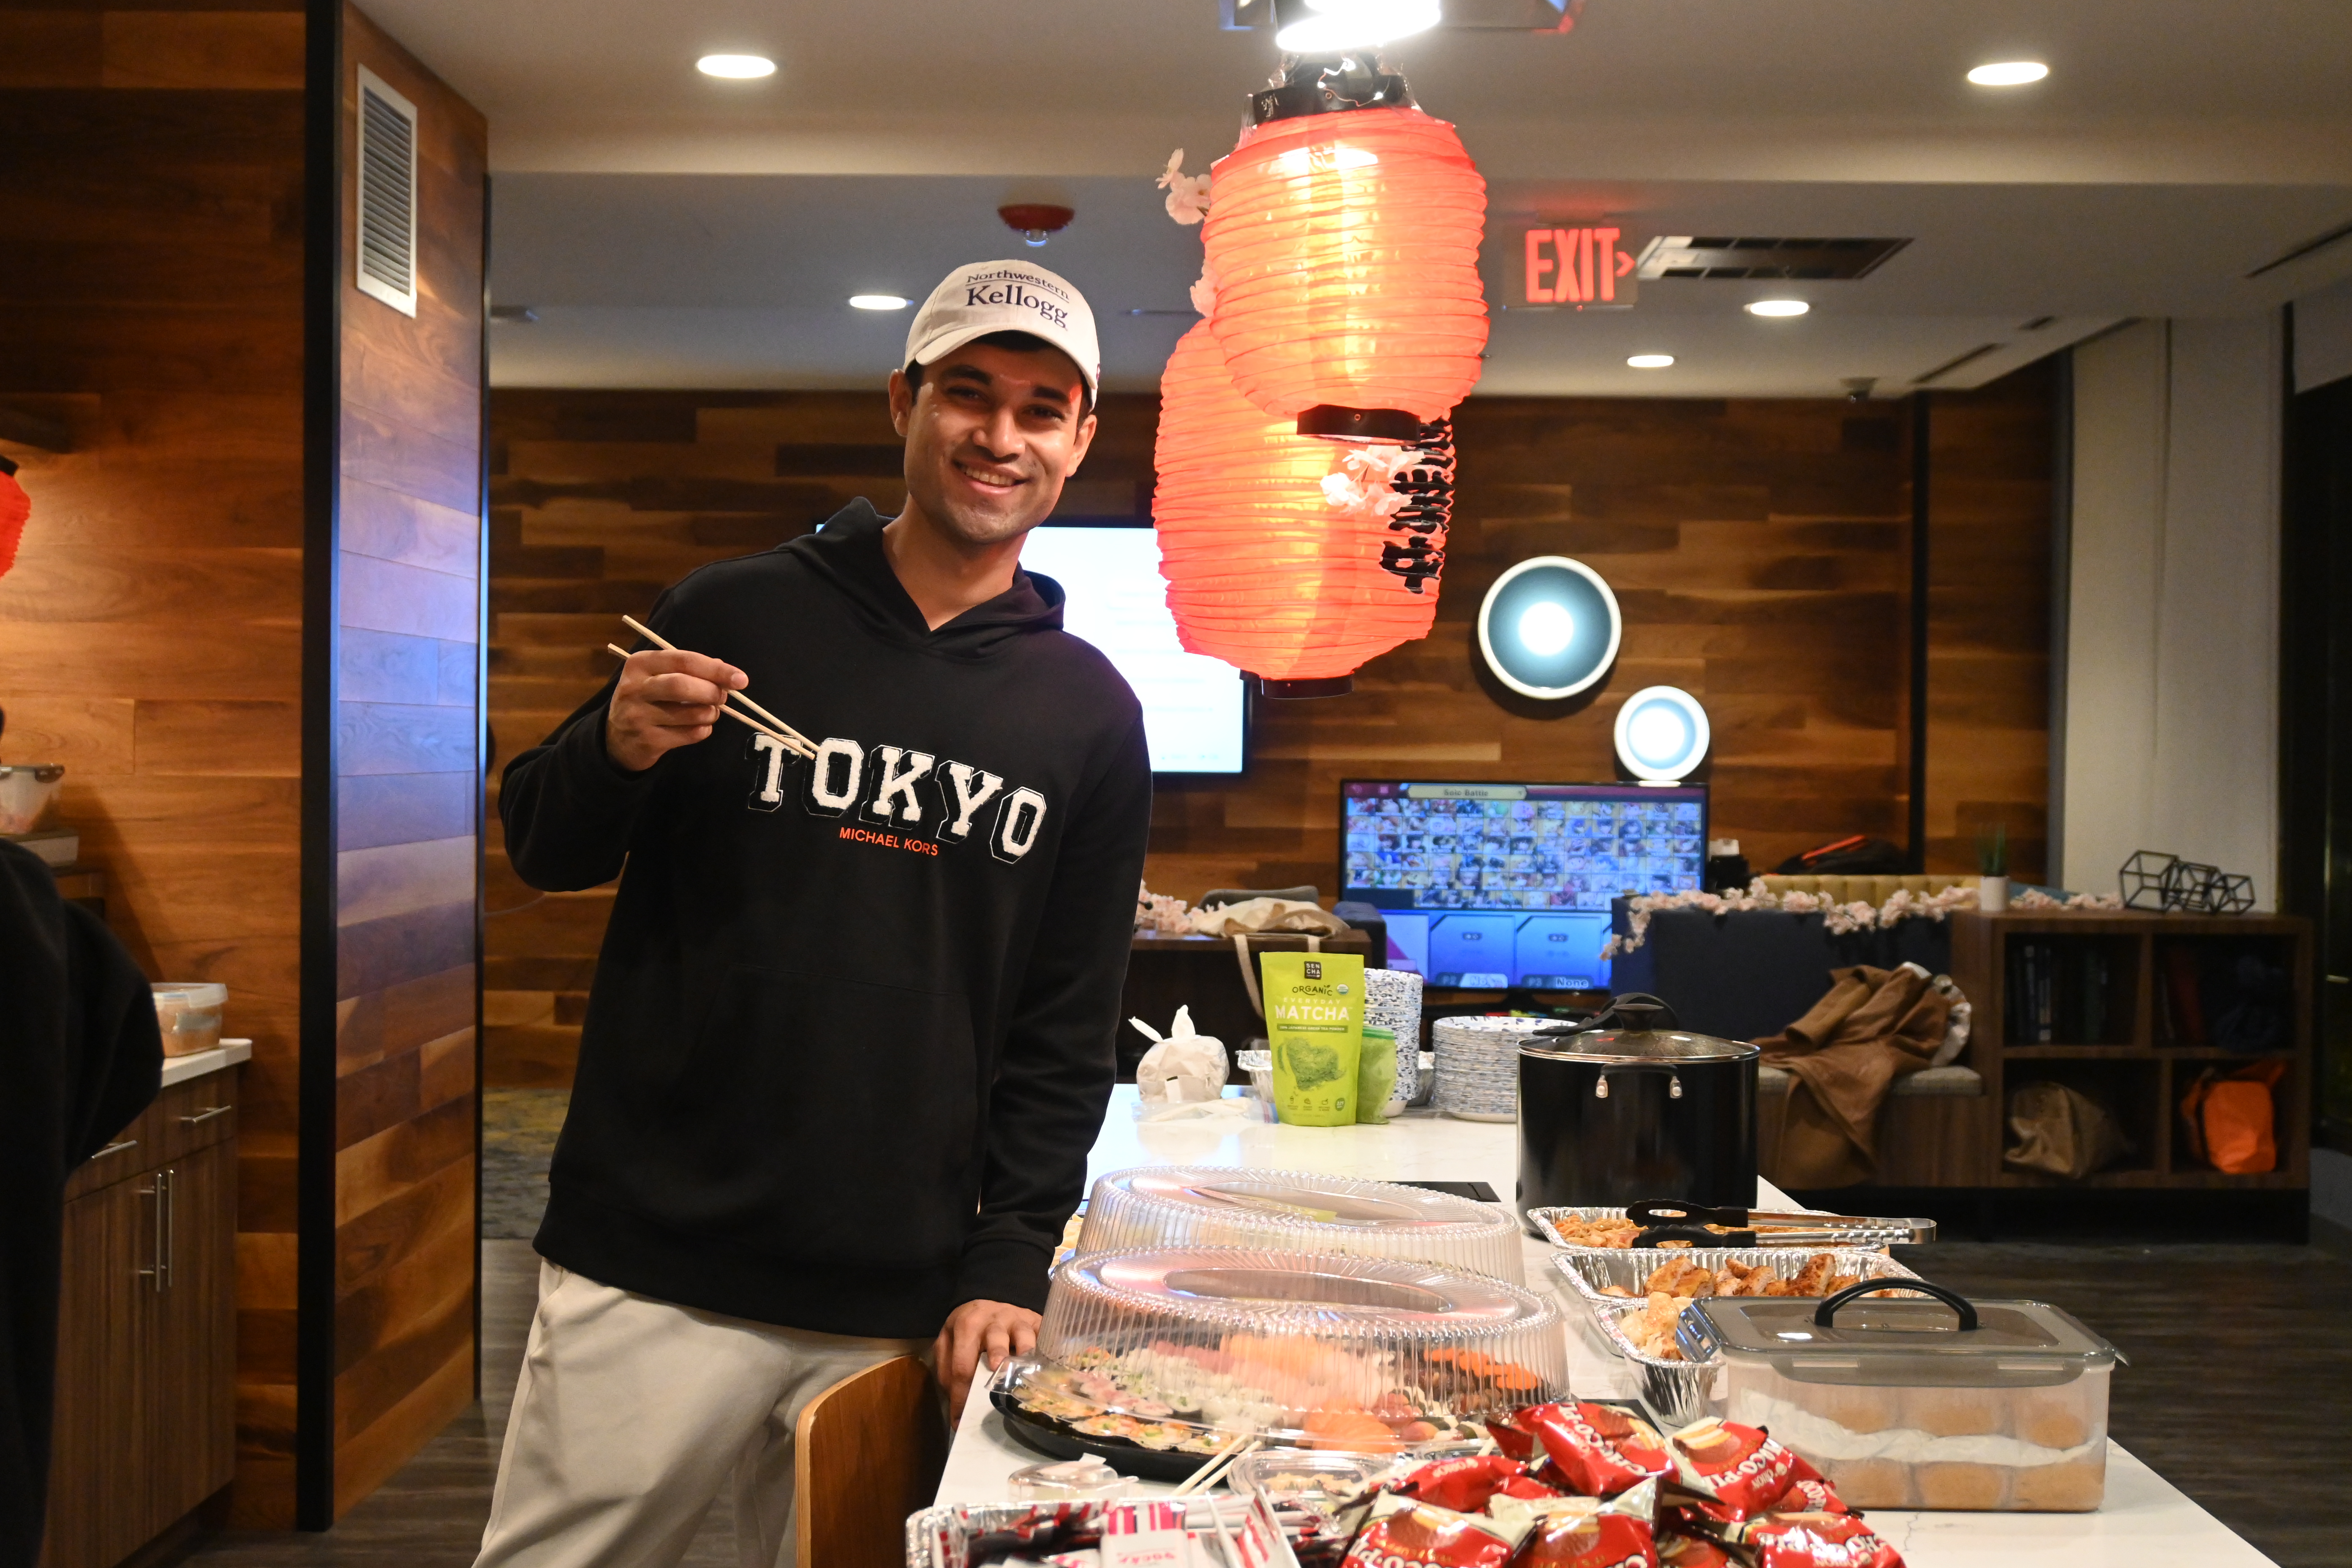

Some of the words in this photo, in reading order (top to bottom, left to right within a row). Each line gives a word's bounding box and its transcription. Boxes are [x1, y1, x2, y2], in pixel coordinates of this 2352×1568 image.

[1525, 228, 1620, 302] EXIT
[966, 270, 1069, 300] Northwestern
[965, 284, 1068, 331] Kellogg
[745, 732, 1047, 864] TOKYO
[839, 827, 899, 848] MICHAEL
[904, 838, 938, 856] KORS
[1292, 985, 1333, 996] ORGANIC
[1555, 977, 1589, 988] None
[1275, 1005, 1350, 1021] MATCHA
